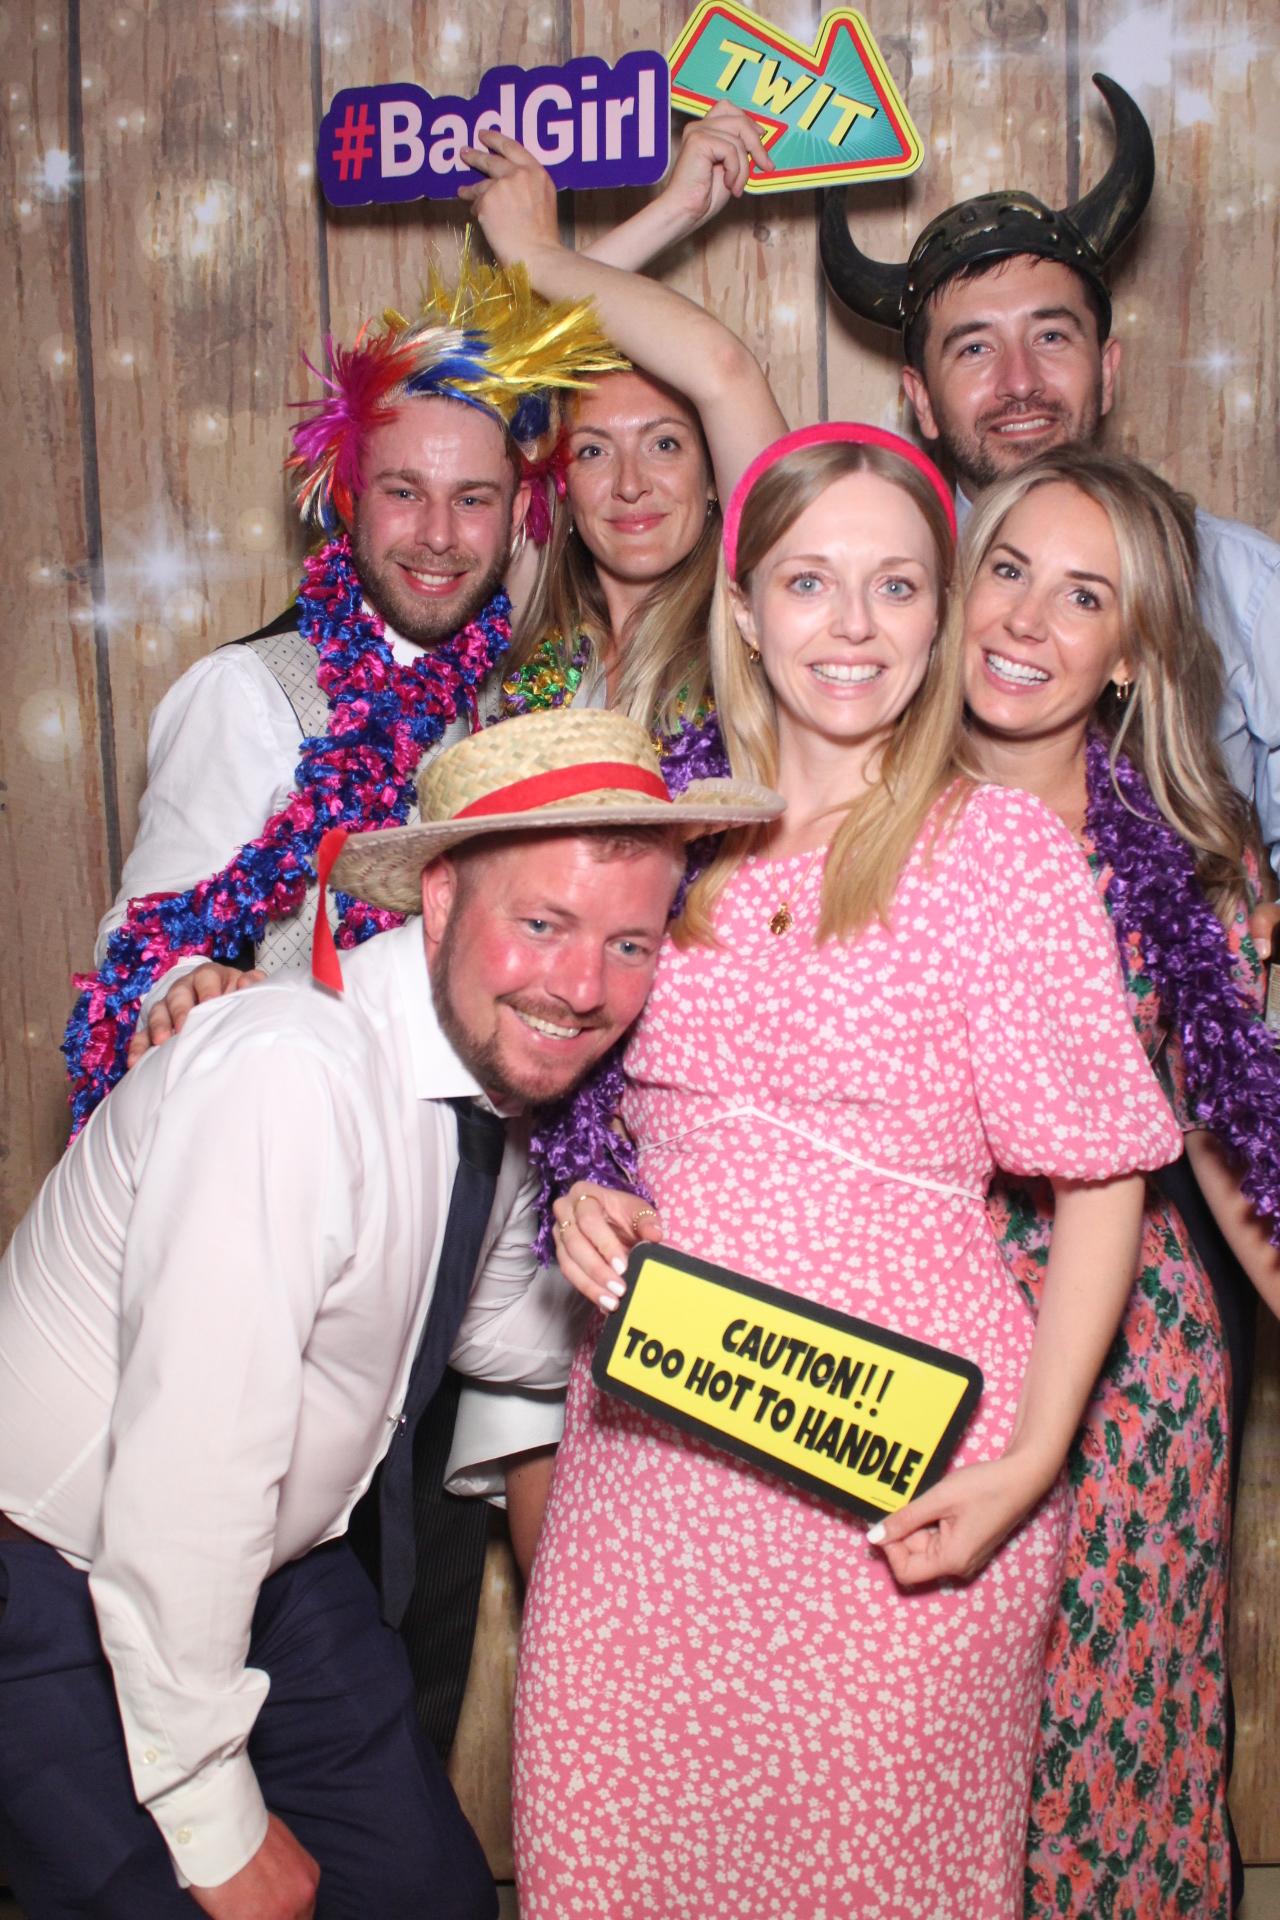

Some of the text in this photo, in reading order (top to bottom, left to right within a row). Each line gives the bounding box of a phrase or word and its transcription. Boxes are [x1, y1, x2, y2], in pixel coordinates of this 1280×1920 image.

[718, 39, 878, 147] TWIT
[623, 1327, 923, 1495] TOO HOT TO HANDLE
[722, 1319, 894, 1417] CAUTION!!
